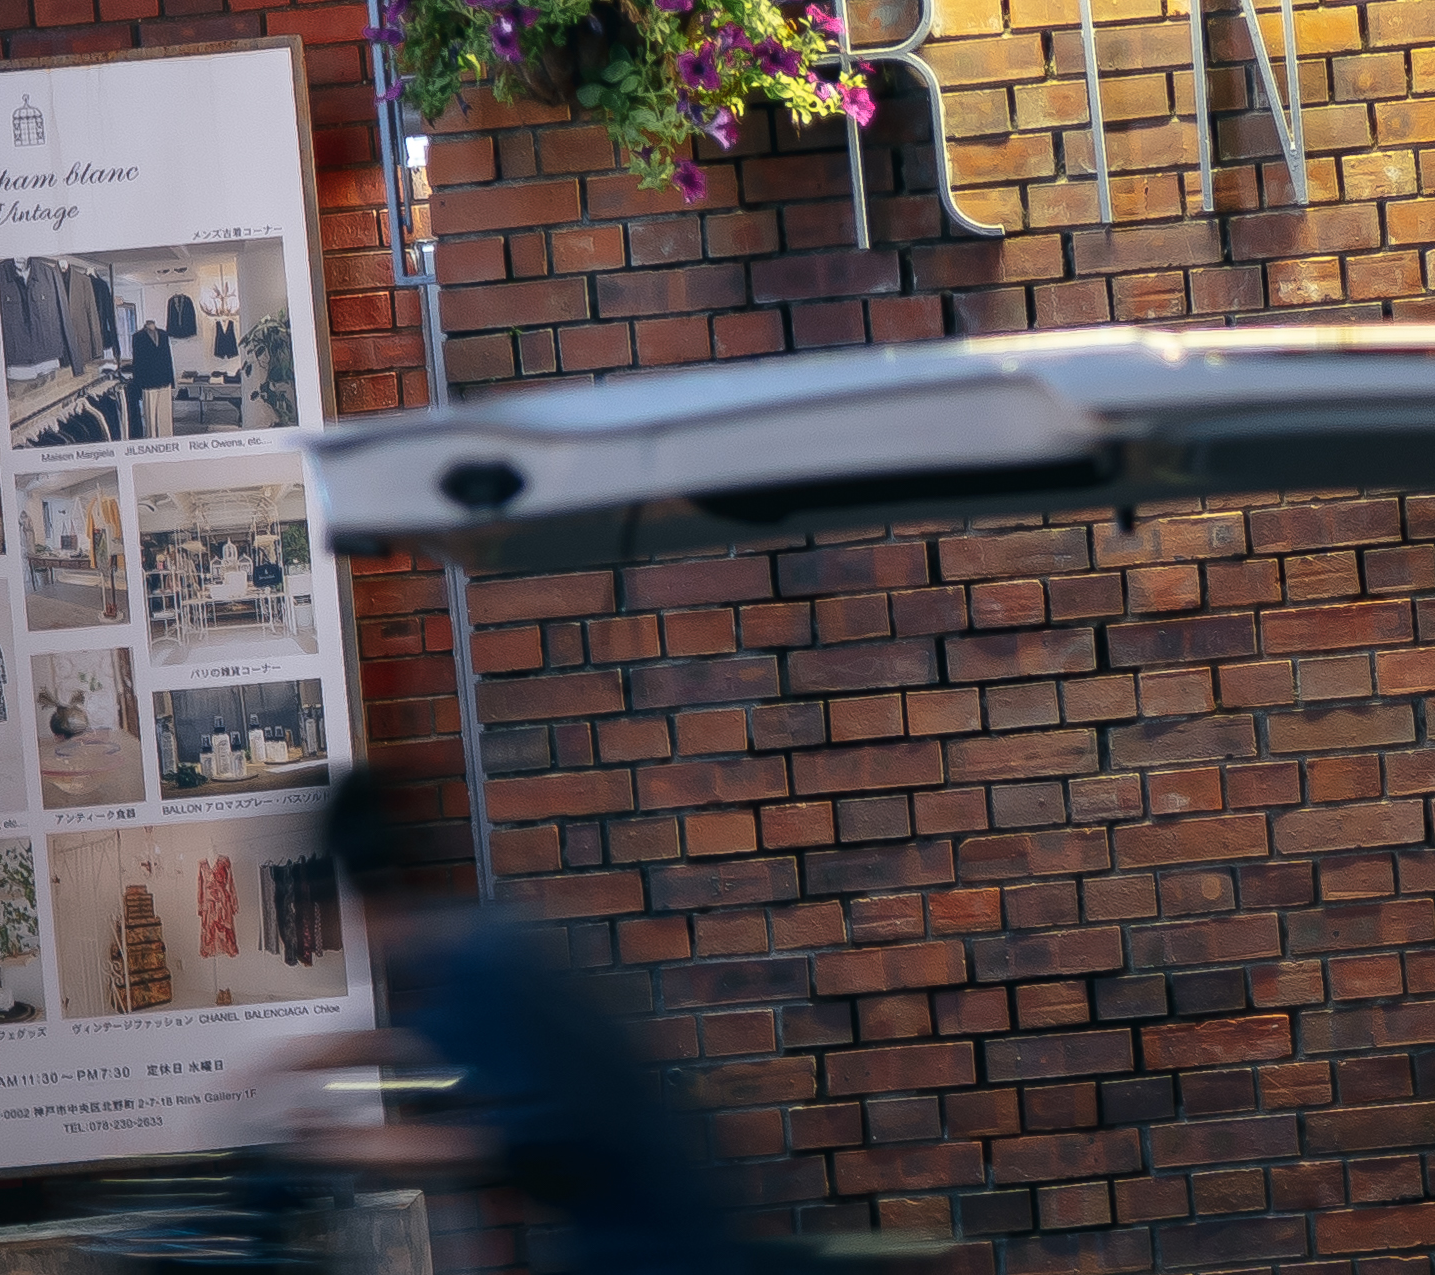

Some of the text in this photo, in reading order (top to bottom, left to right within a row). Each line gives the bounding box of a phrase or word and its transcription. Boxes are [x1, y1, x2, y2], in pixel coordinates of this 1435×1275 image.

[63, 160, 140, 187] blanc
[192, 224, 283, 241] メンズ古着コーナー
[41, 451, 75, 463] Maison
[75, 448, 115, 462] Margiela
[189, 439, 210, 451] Rick
[54, 807, 137, 825] アンティーク食器
[161, 803, 202, 817] BALLON
[71, 1015, 194, 1036] ヴィンテージファッション
[198, 1010, 240, 1025] CHANEL
[244, 1005, 309, 1021] BALENCIAGA
[146, 1062, 183, 1077] 定休日
[188, 1059, 224, 1073] 水曜日
[33, 1097, 135, 1118] 神戸市中央区北野町
[175, 1092, 202, 1106] Rin's
[204, 1089, 242, 1104] Gallery
[243, 1088, 258, 1100] 1F
